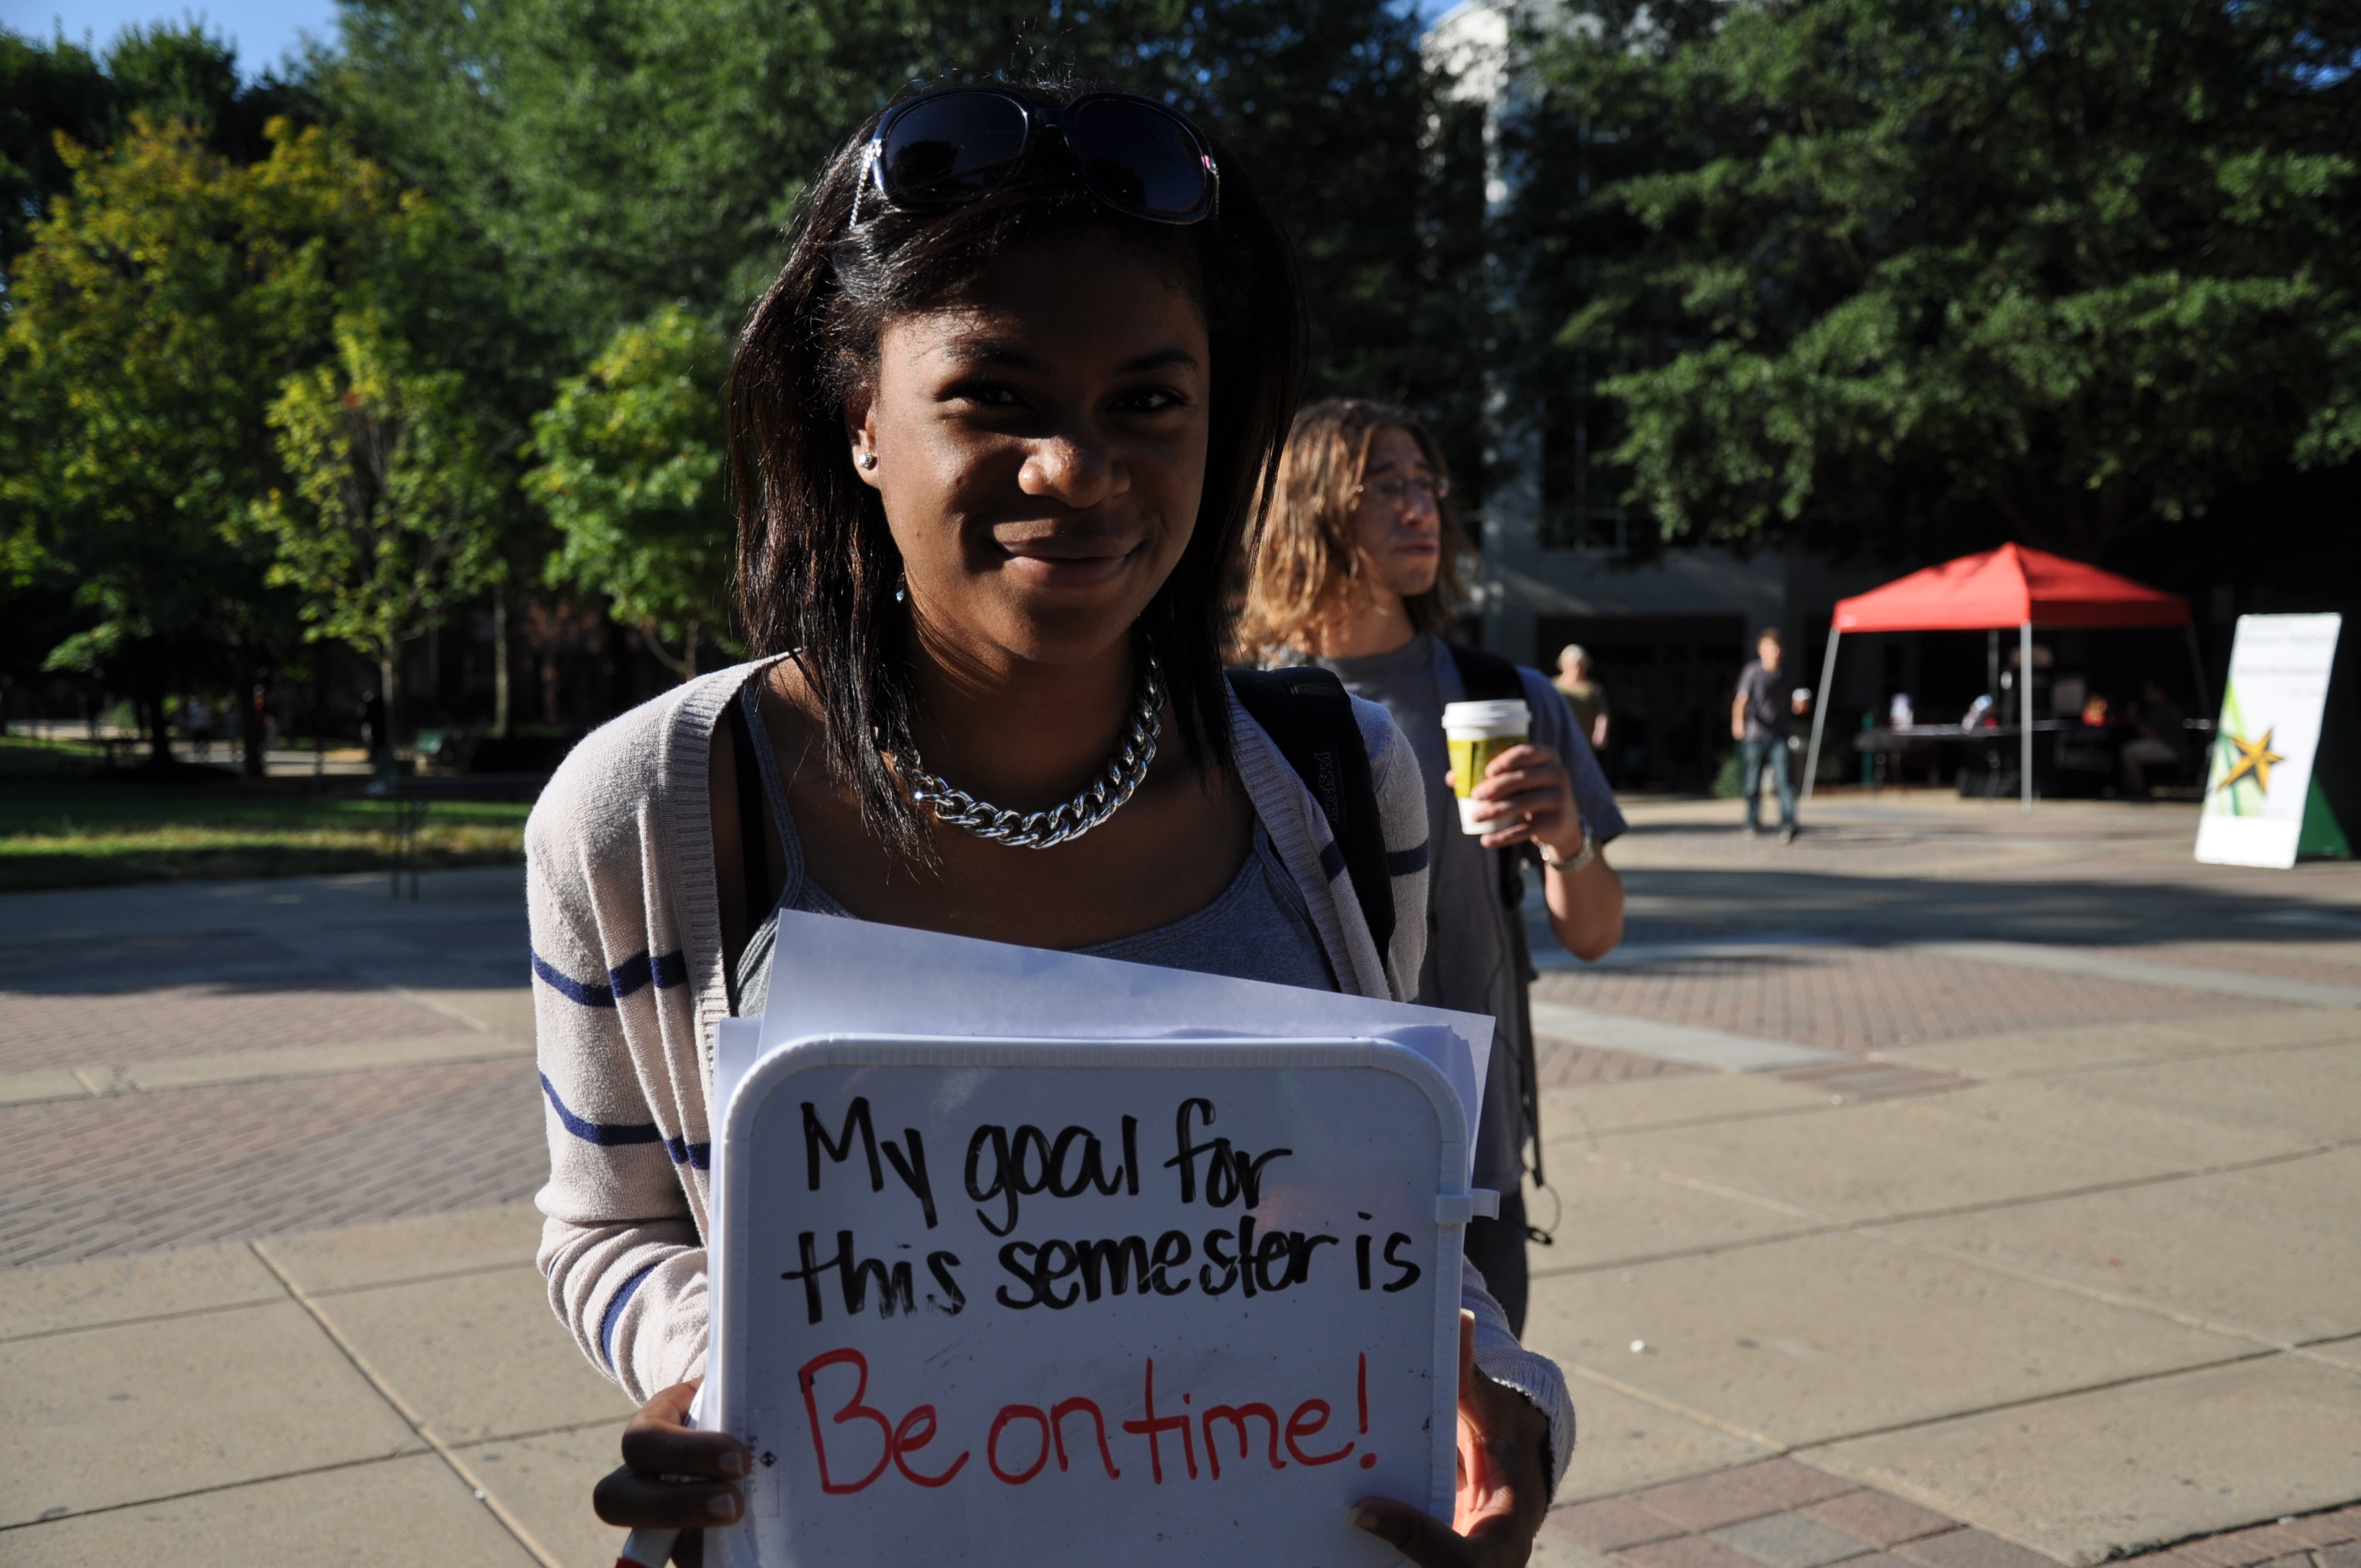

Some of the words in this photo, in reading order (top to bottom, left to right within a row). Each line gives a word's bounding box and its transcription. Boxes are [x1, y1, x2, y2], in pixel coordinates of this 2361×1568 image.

[799, 1097, 937, 1229] My
[965, 1115, 1144, 1237] goal
[1164, 1098, 1293, 1210] for
[781, 1230, 965, 1325] this
[995, 1215, 1339, 1310] semester
[1356, 1212, 1421, 1292] is
[799, 1349, 968, 1494] Be
[988, 1398, 1120, 1484] on
[1123, 1352, 1377, 1482] time!
